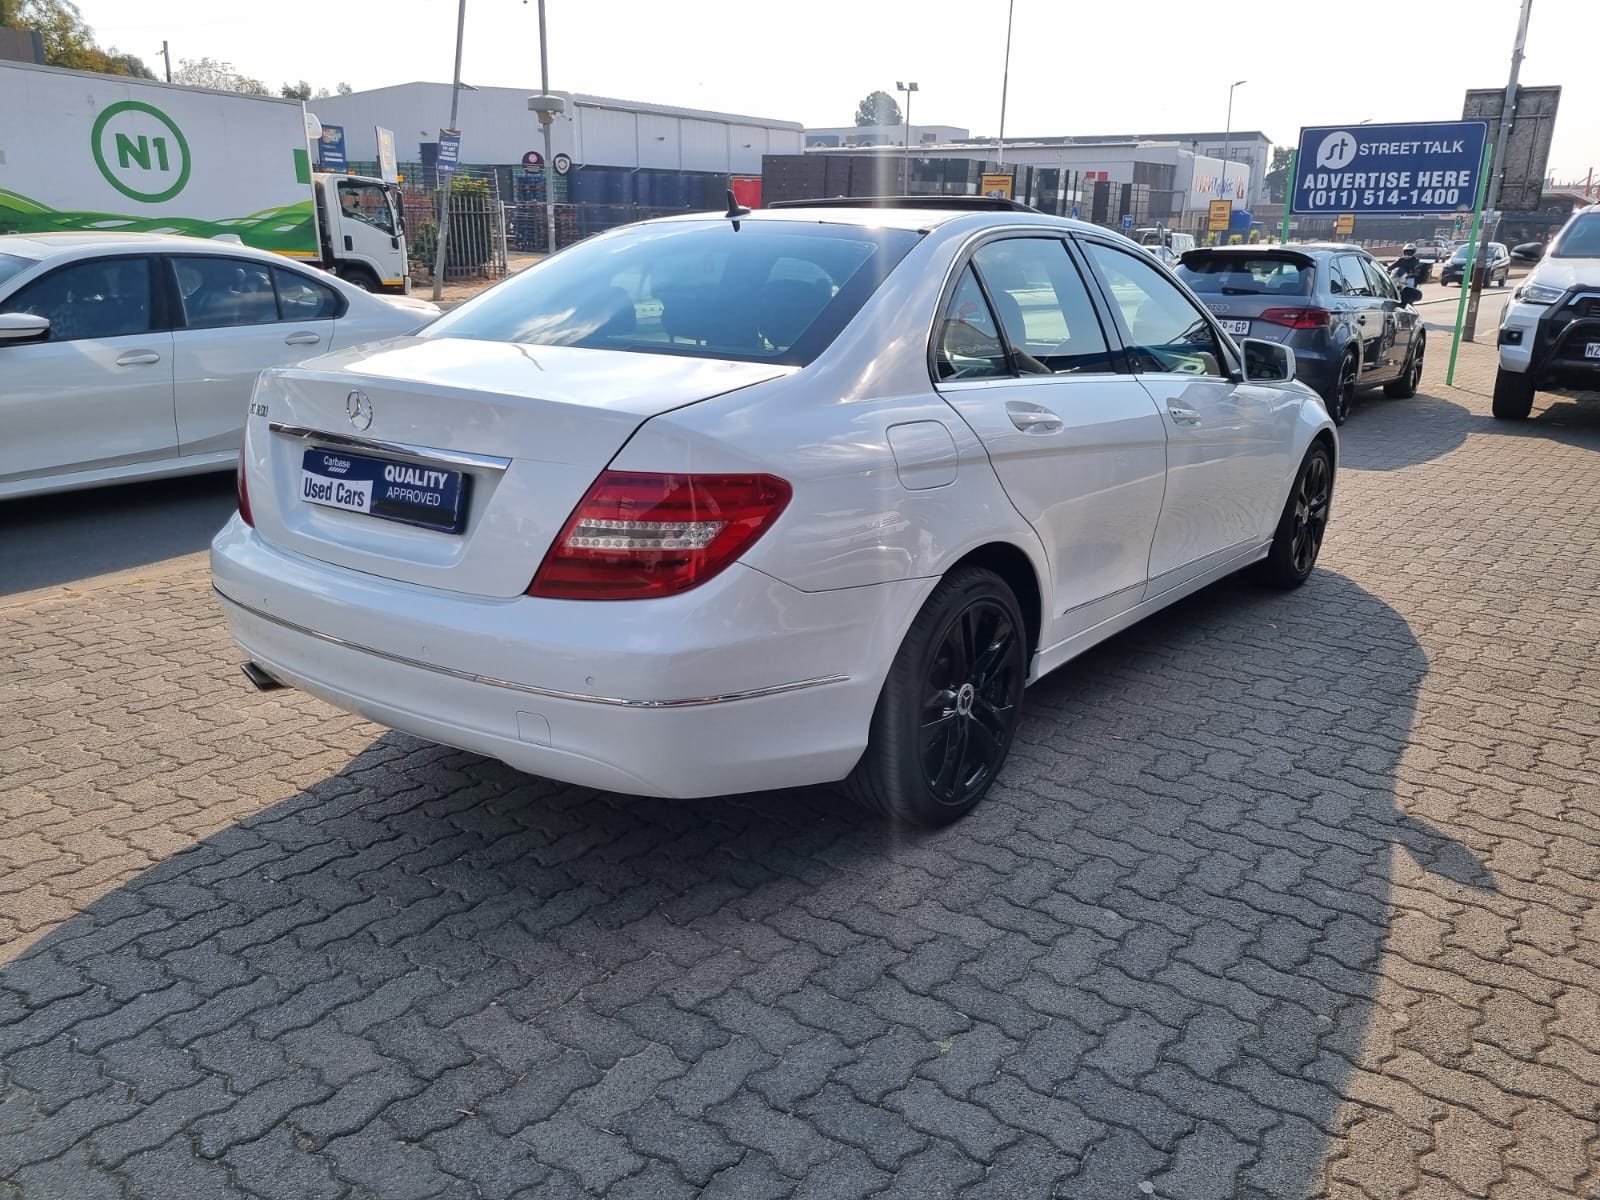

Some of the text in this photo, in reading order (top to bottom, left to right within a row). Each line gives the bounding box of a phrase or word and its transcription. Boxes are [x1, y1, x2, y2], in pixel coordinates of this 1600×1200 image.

[115, 133, 169, 171] N1
[1359, 140, 1464, 156] STREET TALK
[1303, 170, 1471, 190] ADVERTISE HERE
[1308, 188, 1459, 209] (011) 514-1400
[1235, 321, 1247, 333] GP
[323, 455, 351, 468] Carbase
[384, 465, 449, 489] QUALITY
[304, 477, 365, 507] Used Cars
[386, 487, 441, 507] APPROVED
